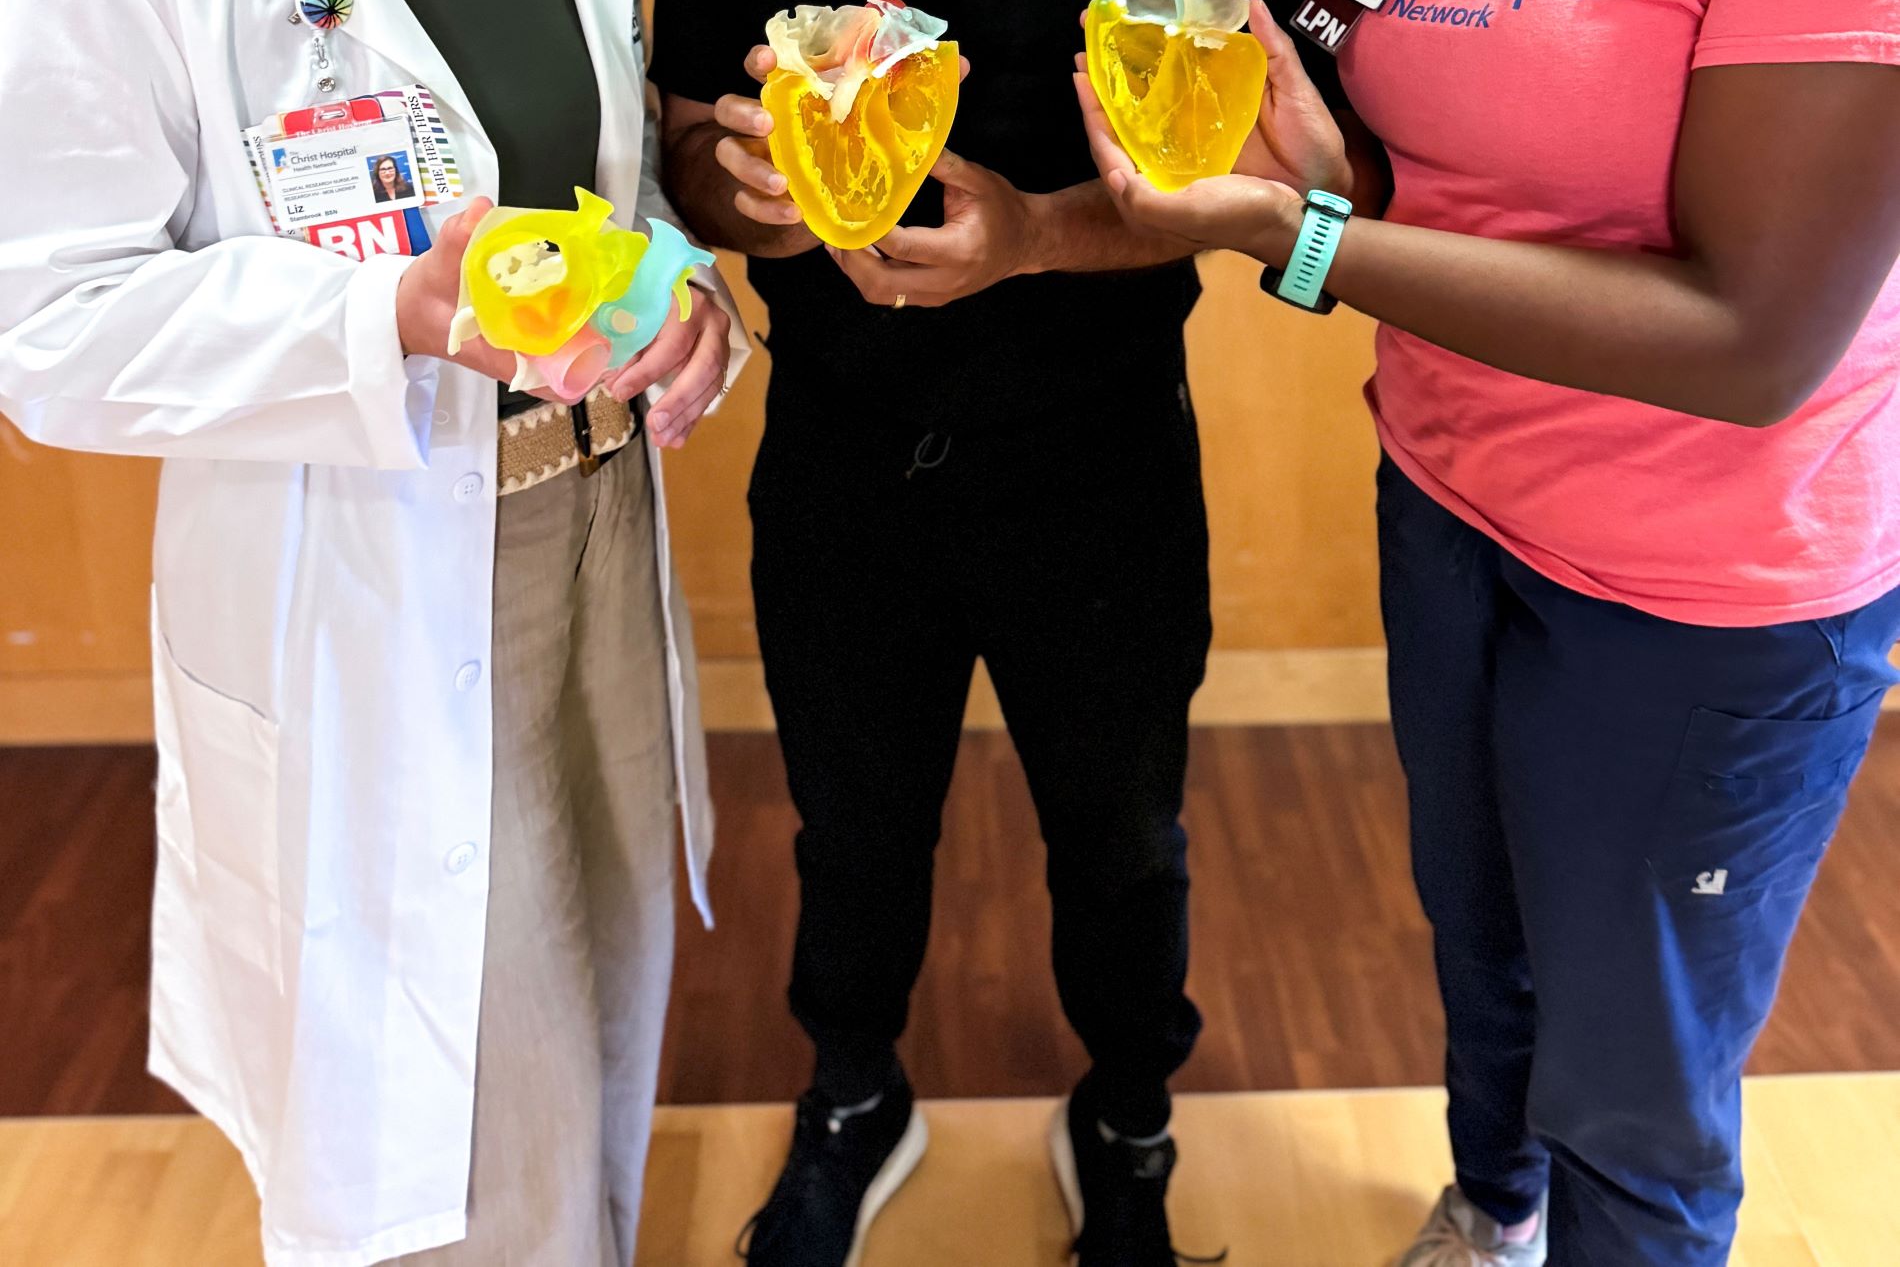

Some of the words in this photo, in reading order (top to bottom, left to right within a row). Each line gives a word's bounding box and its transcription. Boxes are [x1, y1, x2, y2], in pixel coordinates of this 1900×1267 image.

[1295, 0, 1347, 48] LPN
[407, 95, 427, 128] HERS
[290, 153, 318, 165] Christ
[320, 145, 357, 160] Hospital
[421, 135, 438, 161] HER
[432, 168, 449, 194] SHE
[287, 205, 304, 215] Liz
[317, 216, 400, 262] RN
